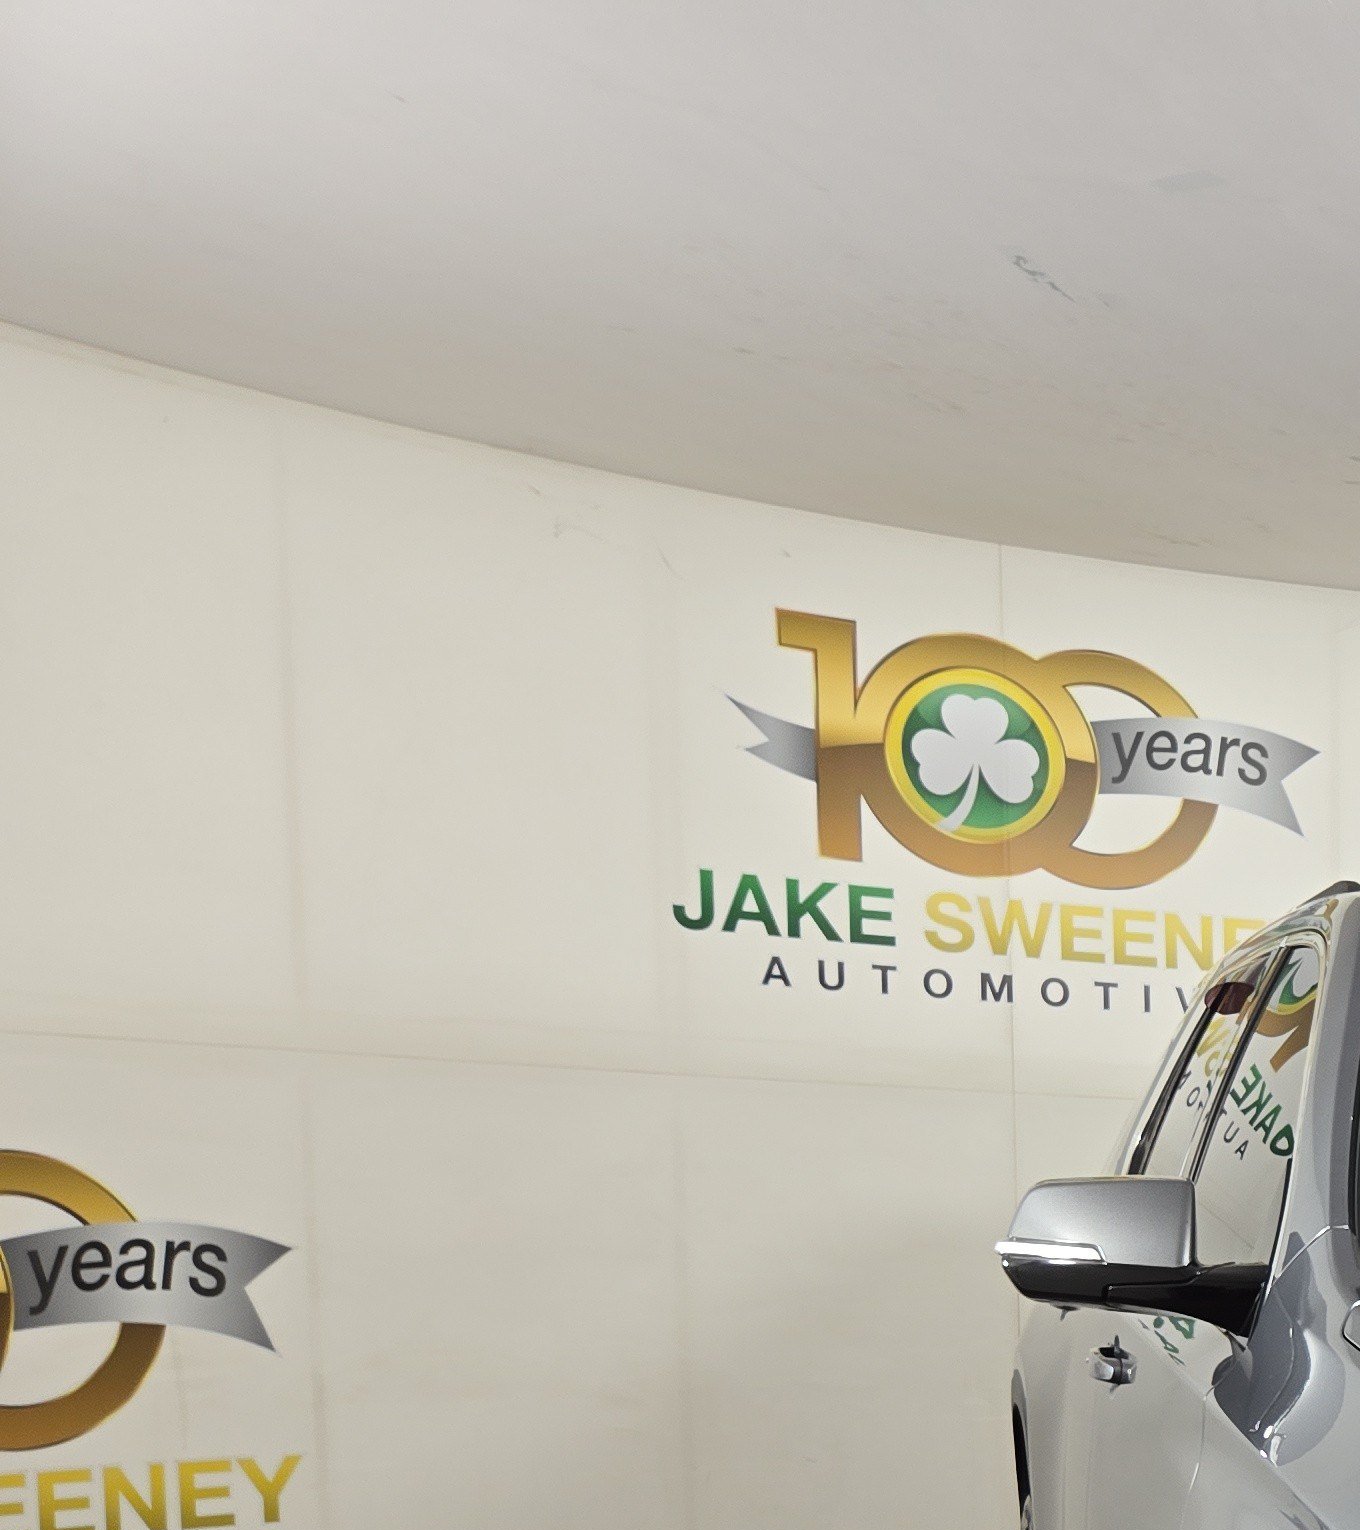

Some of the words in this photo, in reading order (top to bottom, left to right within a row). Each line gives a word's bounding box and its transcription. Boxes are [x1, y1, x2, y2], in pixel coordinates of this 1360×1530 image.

[1110, 713, 1269, 787] years
[672, 867, 898, 946] JAKE
[923, 890, 1267, 971] SWEENE
[762, 955, 1190, 1014] AUTOMOTI
[26, 1236, 228, 1317] years
